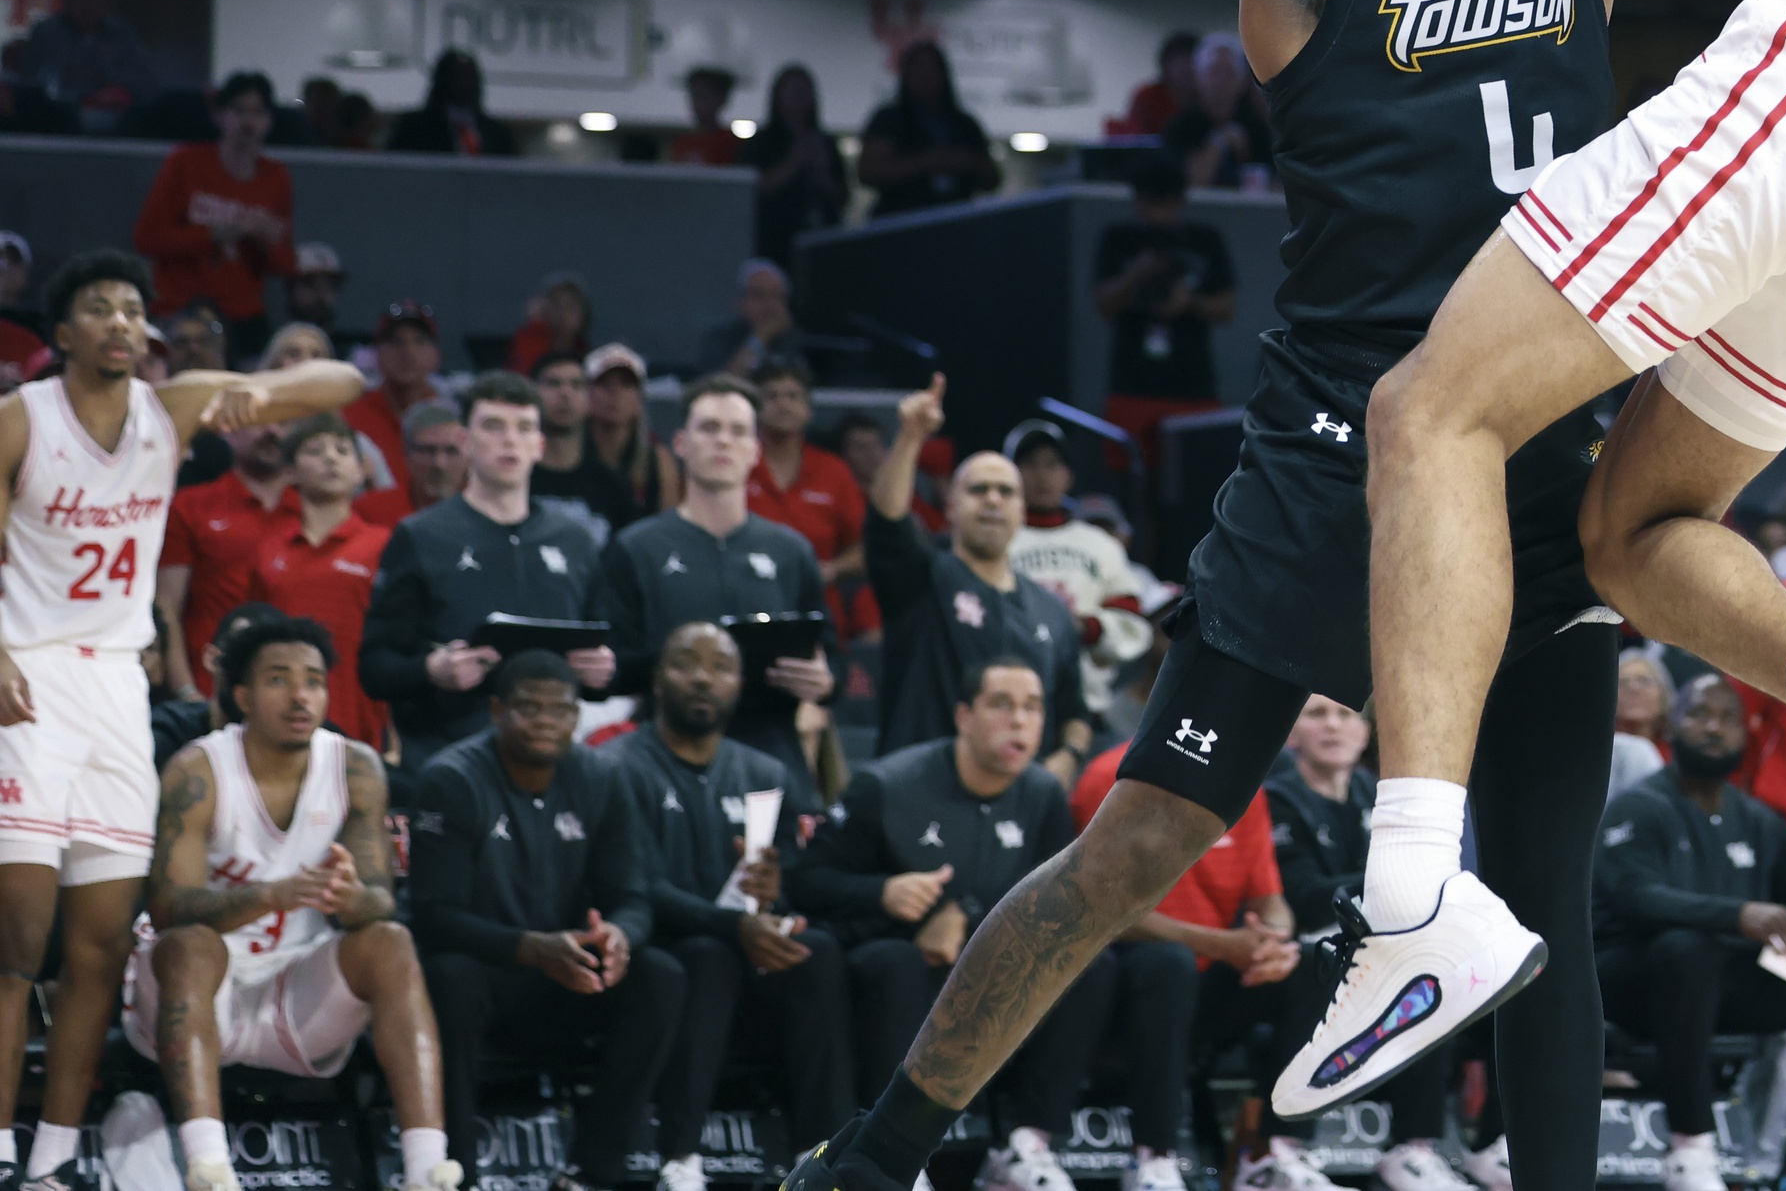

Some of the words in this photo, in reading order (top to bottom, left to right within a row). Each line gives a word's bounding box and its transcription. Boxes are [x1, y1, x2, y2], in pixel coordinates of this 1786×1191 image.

[45, 486, 164, 528] Houston
[68, 536, 137, 600] 24
[1165, 739, 1185, 754] UNDER
[1183, 749, 1210, 766] ARMOUR
